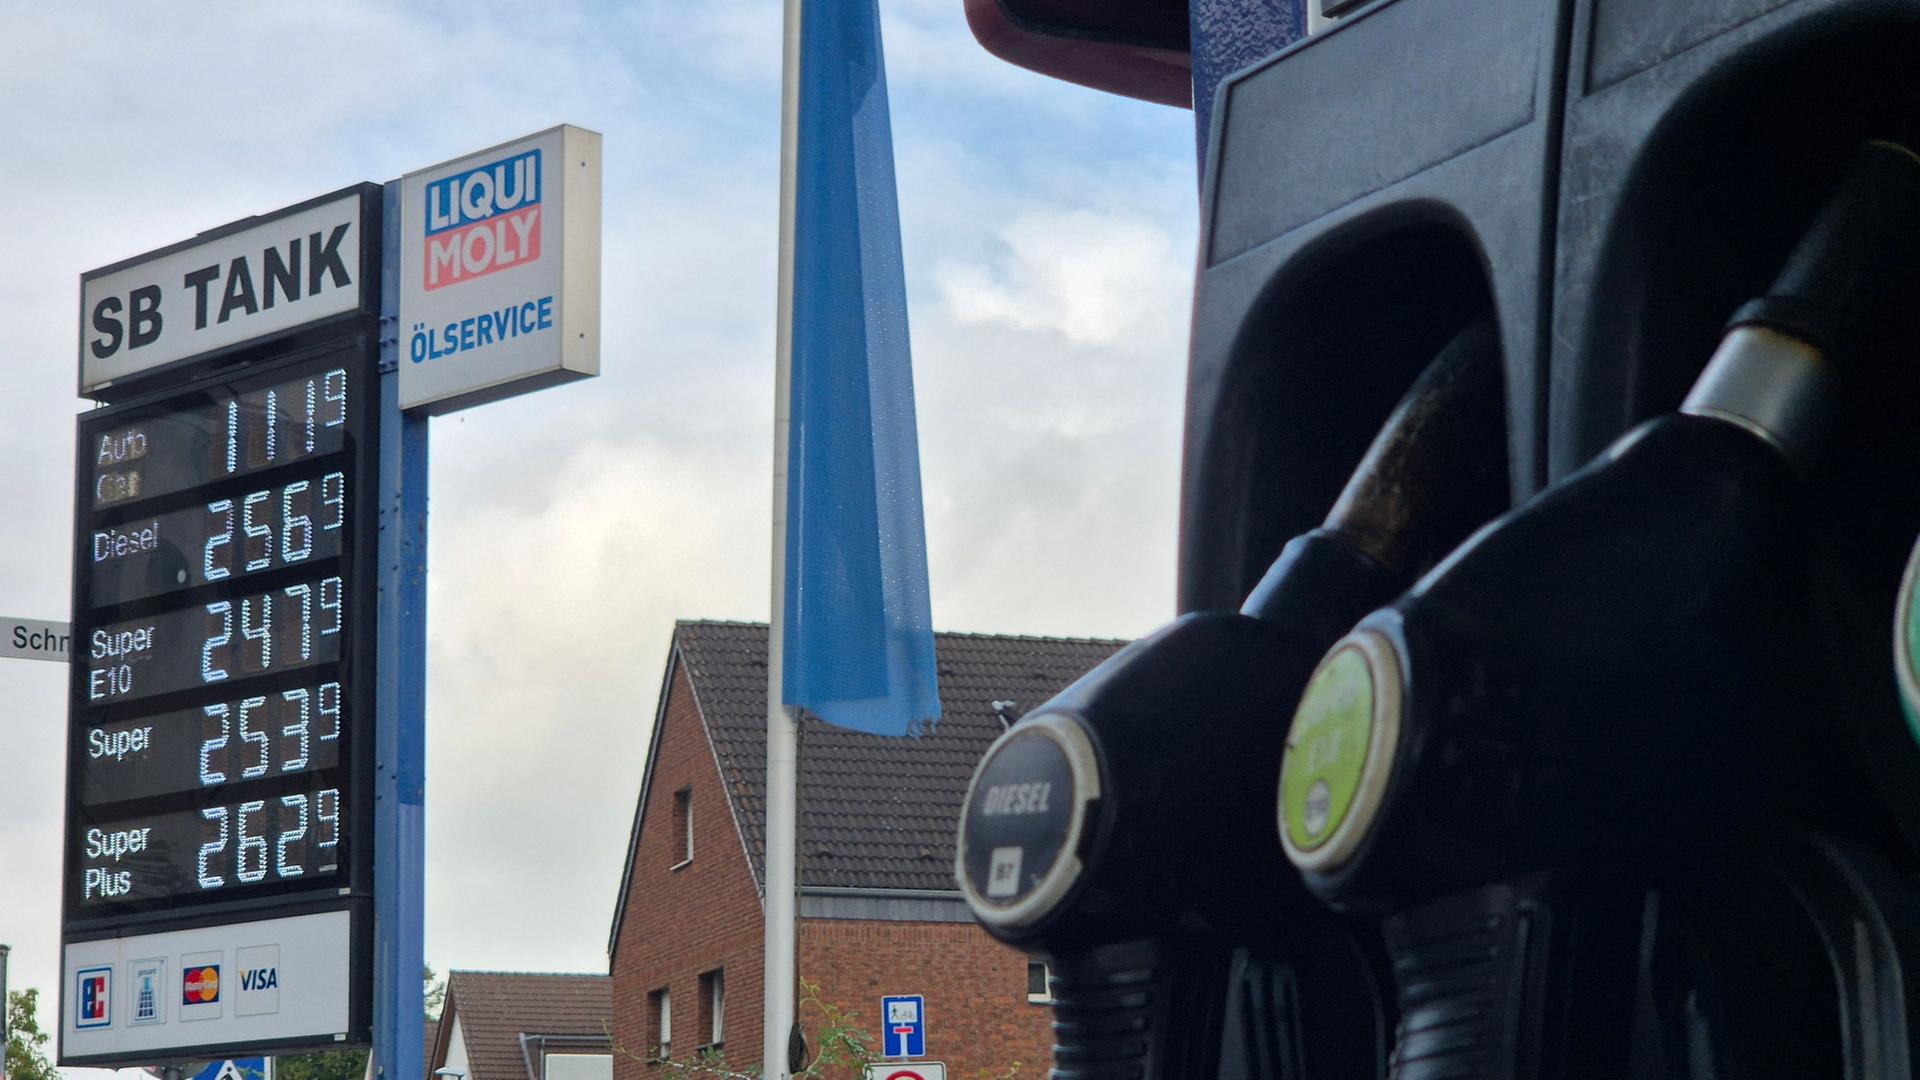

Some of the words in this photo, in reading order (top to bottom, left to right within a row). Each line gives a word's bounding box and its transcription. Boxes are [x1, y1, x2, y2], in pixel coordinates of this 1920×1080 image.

[430, 154, 538, 231] LIQUI
[429, 208, 540, 285] MOLY
[90, 283, 163, 358] SB
[184, 222, 352, 330] TANK
[410, 295, 554, 363] ÖLSERVICE
[94, 520, 159, 562] Diesel
[91, 625, 155, 660] Super
[89, 664, 132, 699] E10
[88, 726, 152, 762] Super
[982, 782, 1052, 816] DIESEL
[85, 827, 152, 861] Super
[84, 867, 131, 899] Plus
[240, 968, 277, 991] VISA
